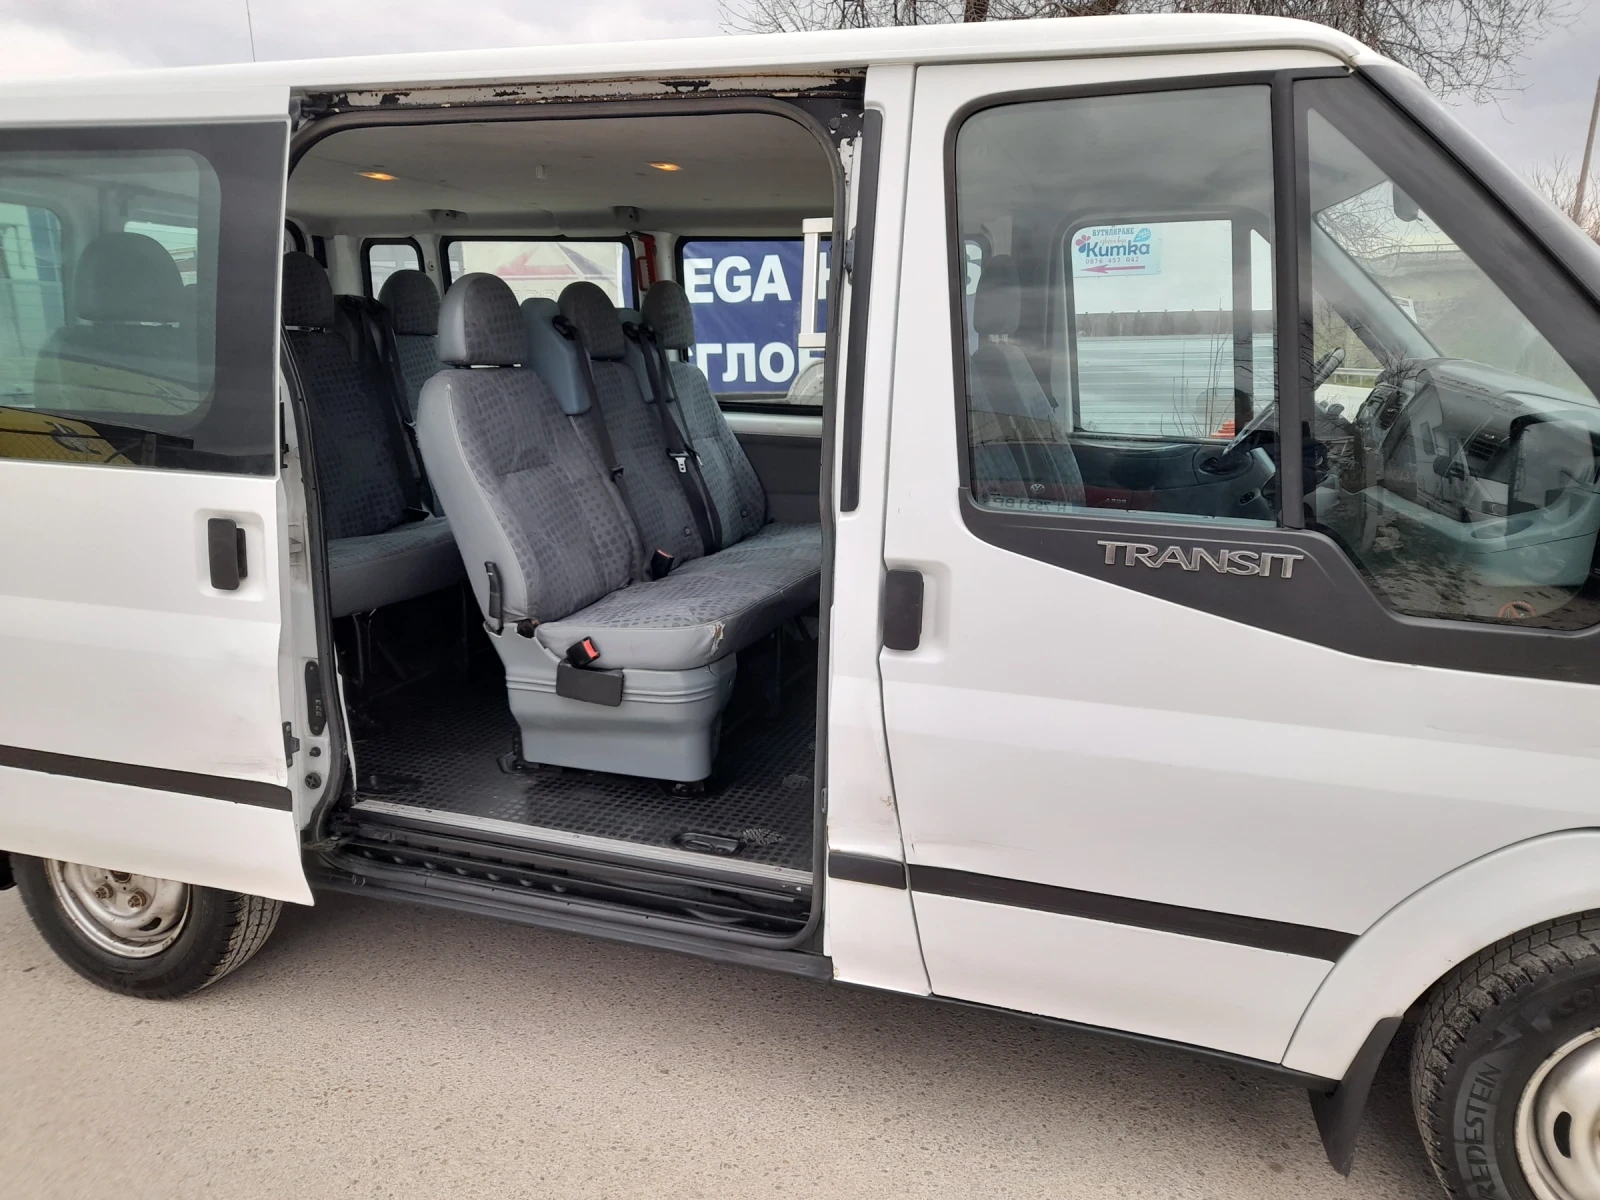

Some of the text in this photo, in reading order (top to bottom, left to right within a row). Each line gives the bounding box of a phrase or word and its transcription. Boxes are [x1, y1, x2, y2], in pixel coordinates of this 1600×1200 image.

[1092, 228, 1134, 236] БУТИЛИРАНЕ
[688, 341, 825, 384] ГЛО
[1097, 540, 1304, 578] TRANSIT
